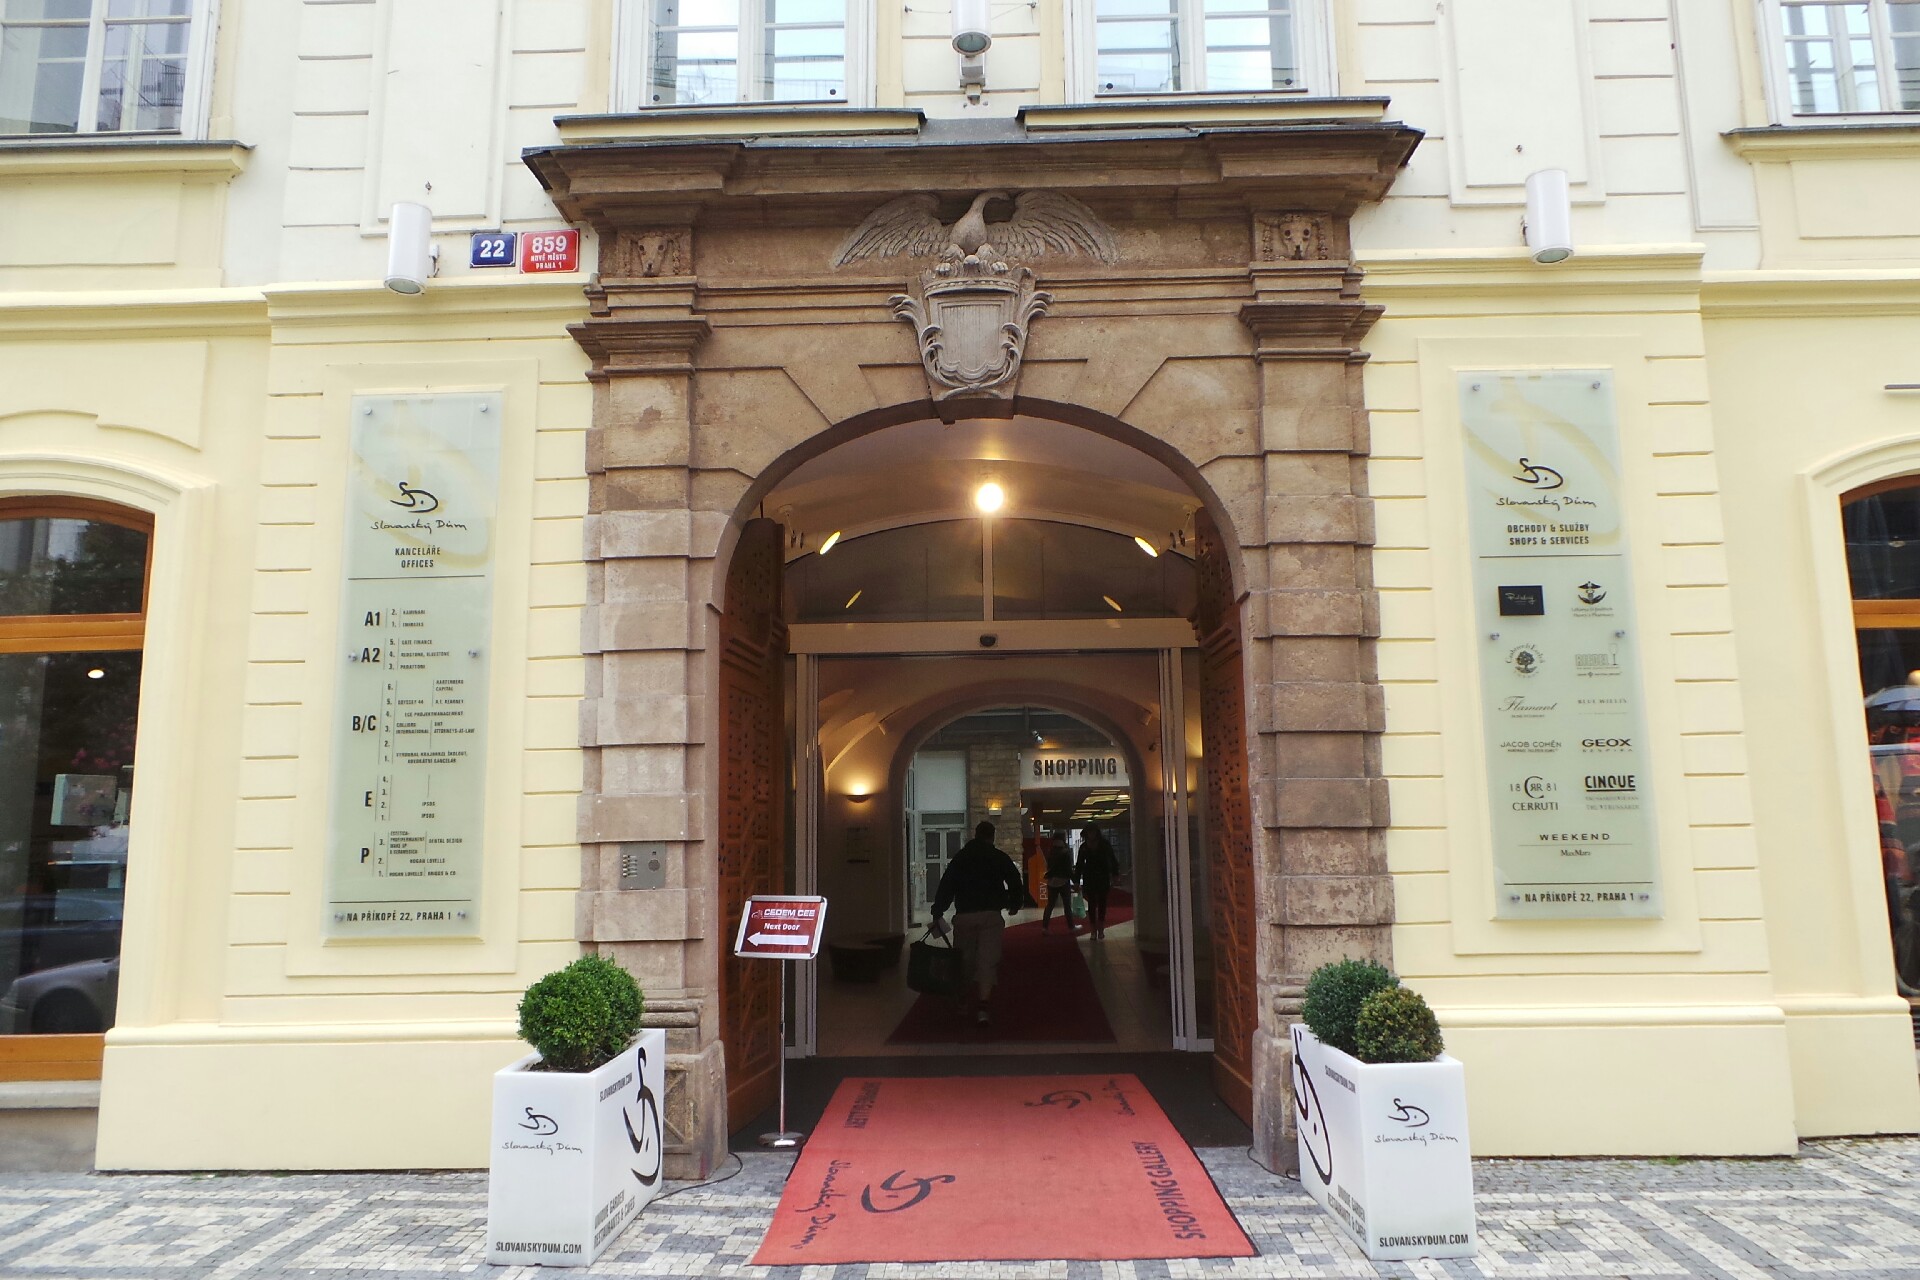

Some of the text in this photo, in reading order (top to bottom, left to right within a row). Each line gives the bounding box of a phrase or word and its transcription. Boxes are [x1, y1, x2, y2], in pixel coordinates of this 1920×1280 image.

[480, 240, 505, 258] 22
[532, 236, 567, 254] 859
[530, 253, 546, 262] NOVÉ
[1507, 524, 1546, 533] OBCHODY
[1560, 522, 1589, 532] SLUŽBY
[1550, 536, 1589, 544] SERVICES
[395, 544, 441, 556] KANCELÁŘE
[401, 560, 434, 568] OFFICES
[364, 611, 380, 626] A1
[361, 648, 380, 662] A2
[352, 715, 376, 733] B/C
[1582, 739, 1632, 747] GEOX
[1033, 758, 1116, 776] SHOPPING
[1585, 775, 1636, 788] CINQUE
[365, 791, 372, 807] E
[1512, 802, 1558, 811] CERRUTI
[360, 847, 370, 863] P
[1525, 894, 1537, 902] NA
[1541, 891, 1576, 902] PŘÍKOPĚ
[1580, 894, 1594, 902] 22,
[347, 912, 358, 921] NA
[361, 910, 396, 921] PŘÍKOPĚ
[400, 912, 413, 921] 22,
[416, 912, 444, 920] PRAHA
[1132, 1141, 1206, 1240] SHOPPING GALLERY
[1379, 1234, 1468, 1247] SLOVANSKYDUM.COM
[496, 1242, 582, 1254] SLOVANSKYDUM.COM
